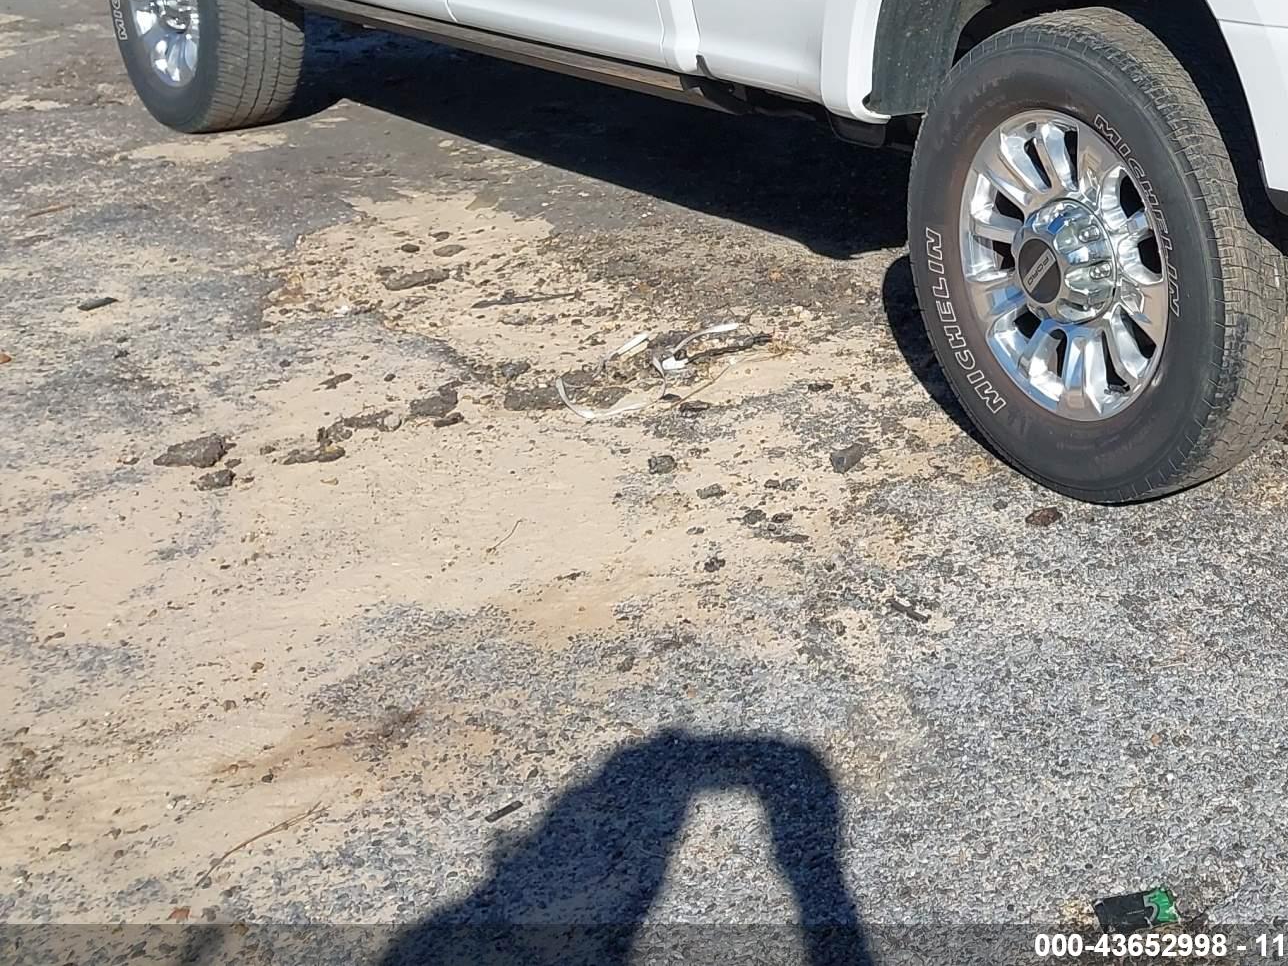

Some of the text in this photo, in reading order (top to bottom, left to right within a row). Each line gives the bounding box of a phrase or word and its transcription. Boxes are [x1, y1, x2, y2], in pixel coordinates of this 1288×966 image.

[1027, 256, 1050, 286] FORD
[1094, 113, 1180, 318] MICHELIN
[925, 226, 1007, 414] MICHELIN
